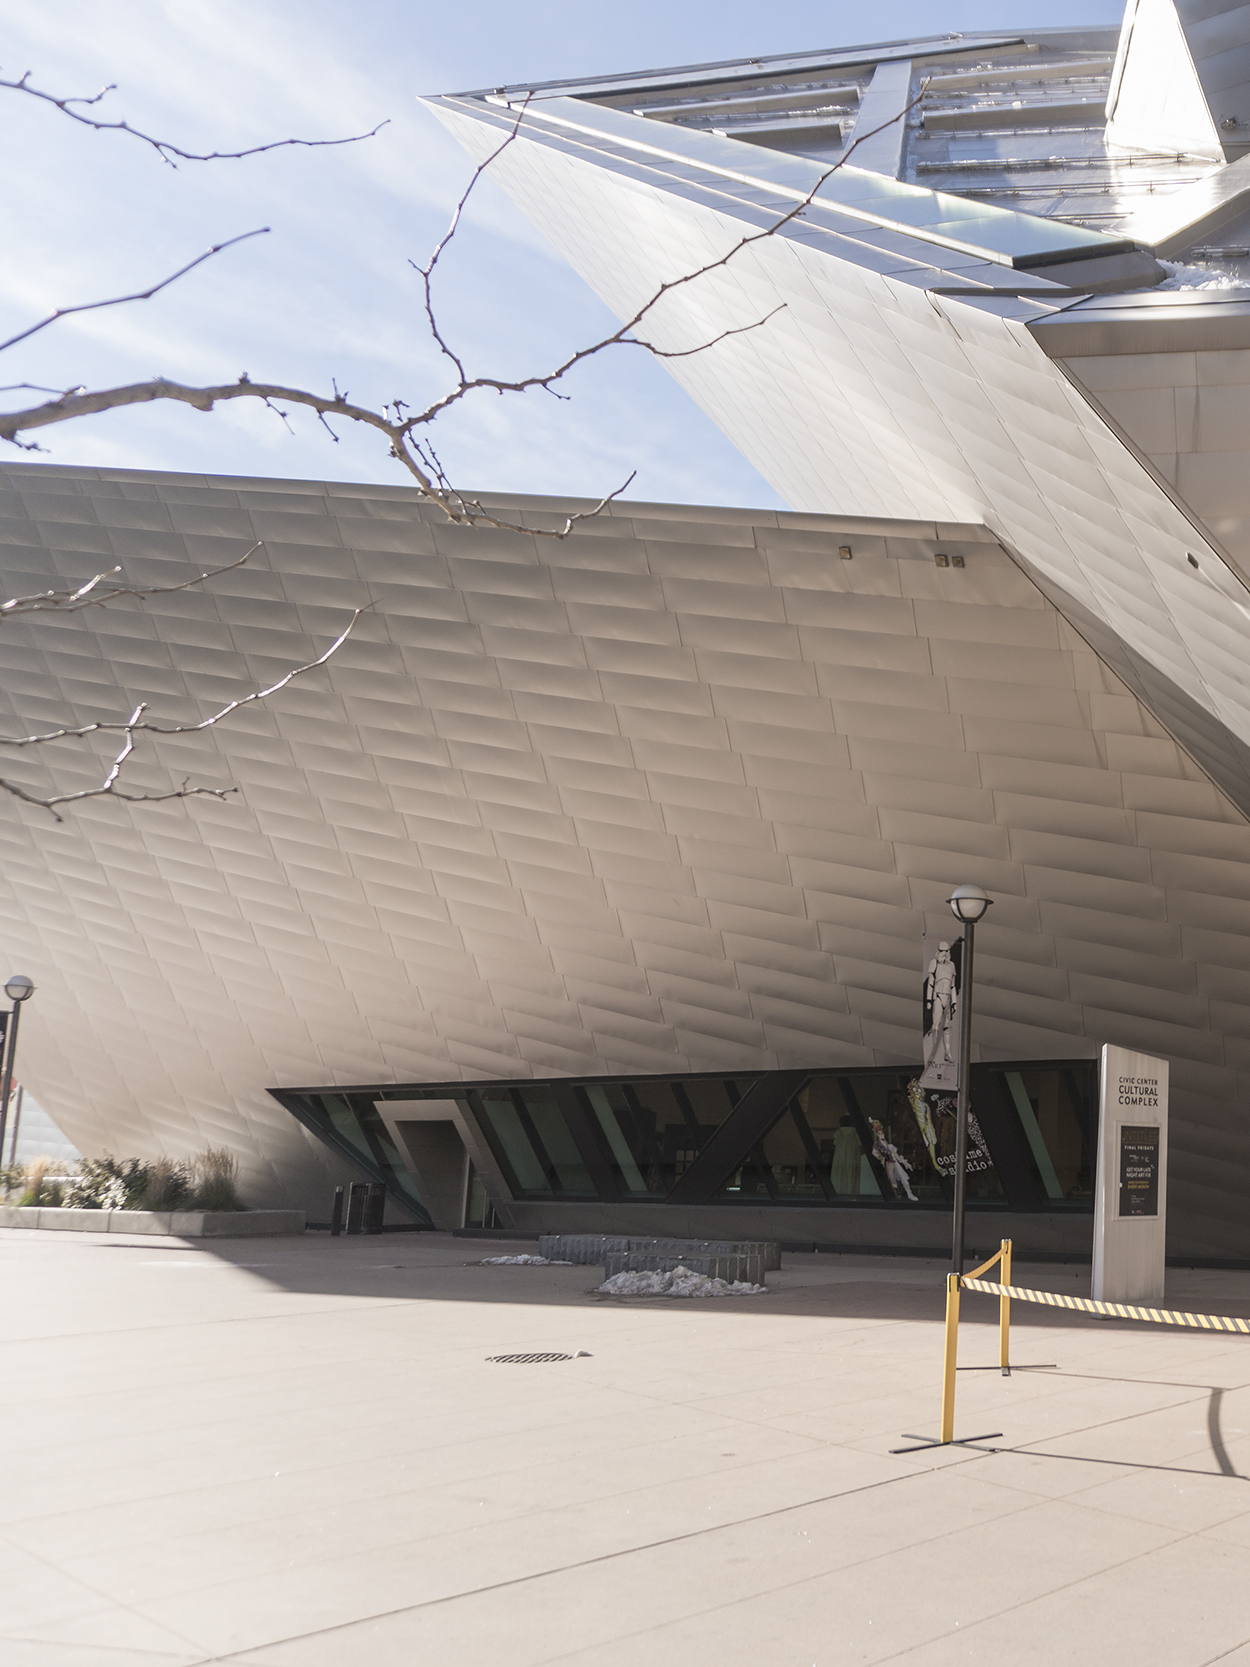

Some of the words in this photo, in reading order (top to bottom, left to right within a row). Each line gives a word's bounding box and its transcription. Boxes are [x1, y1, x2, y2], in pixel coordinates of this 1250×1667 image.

[1118, 1076, 1135, 1084] CIVIC
[1136, 1077, 1158, 1085] CENTER
[1118, 1085, 1158, 1096] CULTURAL
[1118, 1095, 1158, 1107] COMPLEX
[1121, 1130, 1159, 1142] UNTITLED
[937, 1149, 983, 1165] cosme
[948, 1160, 987, 1175] sdio
